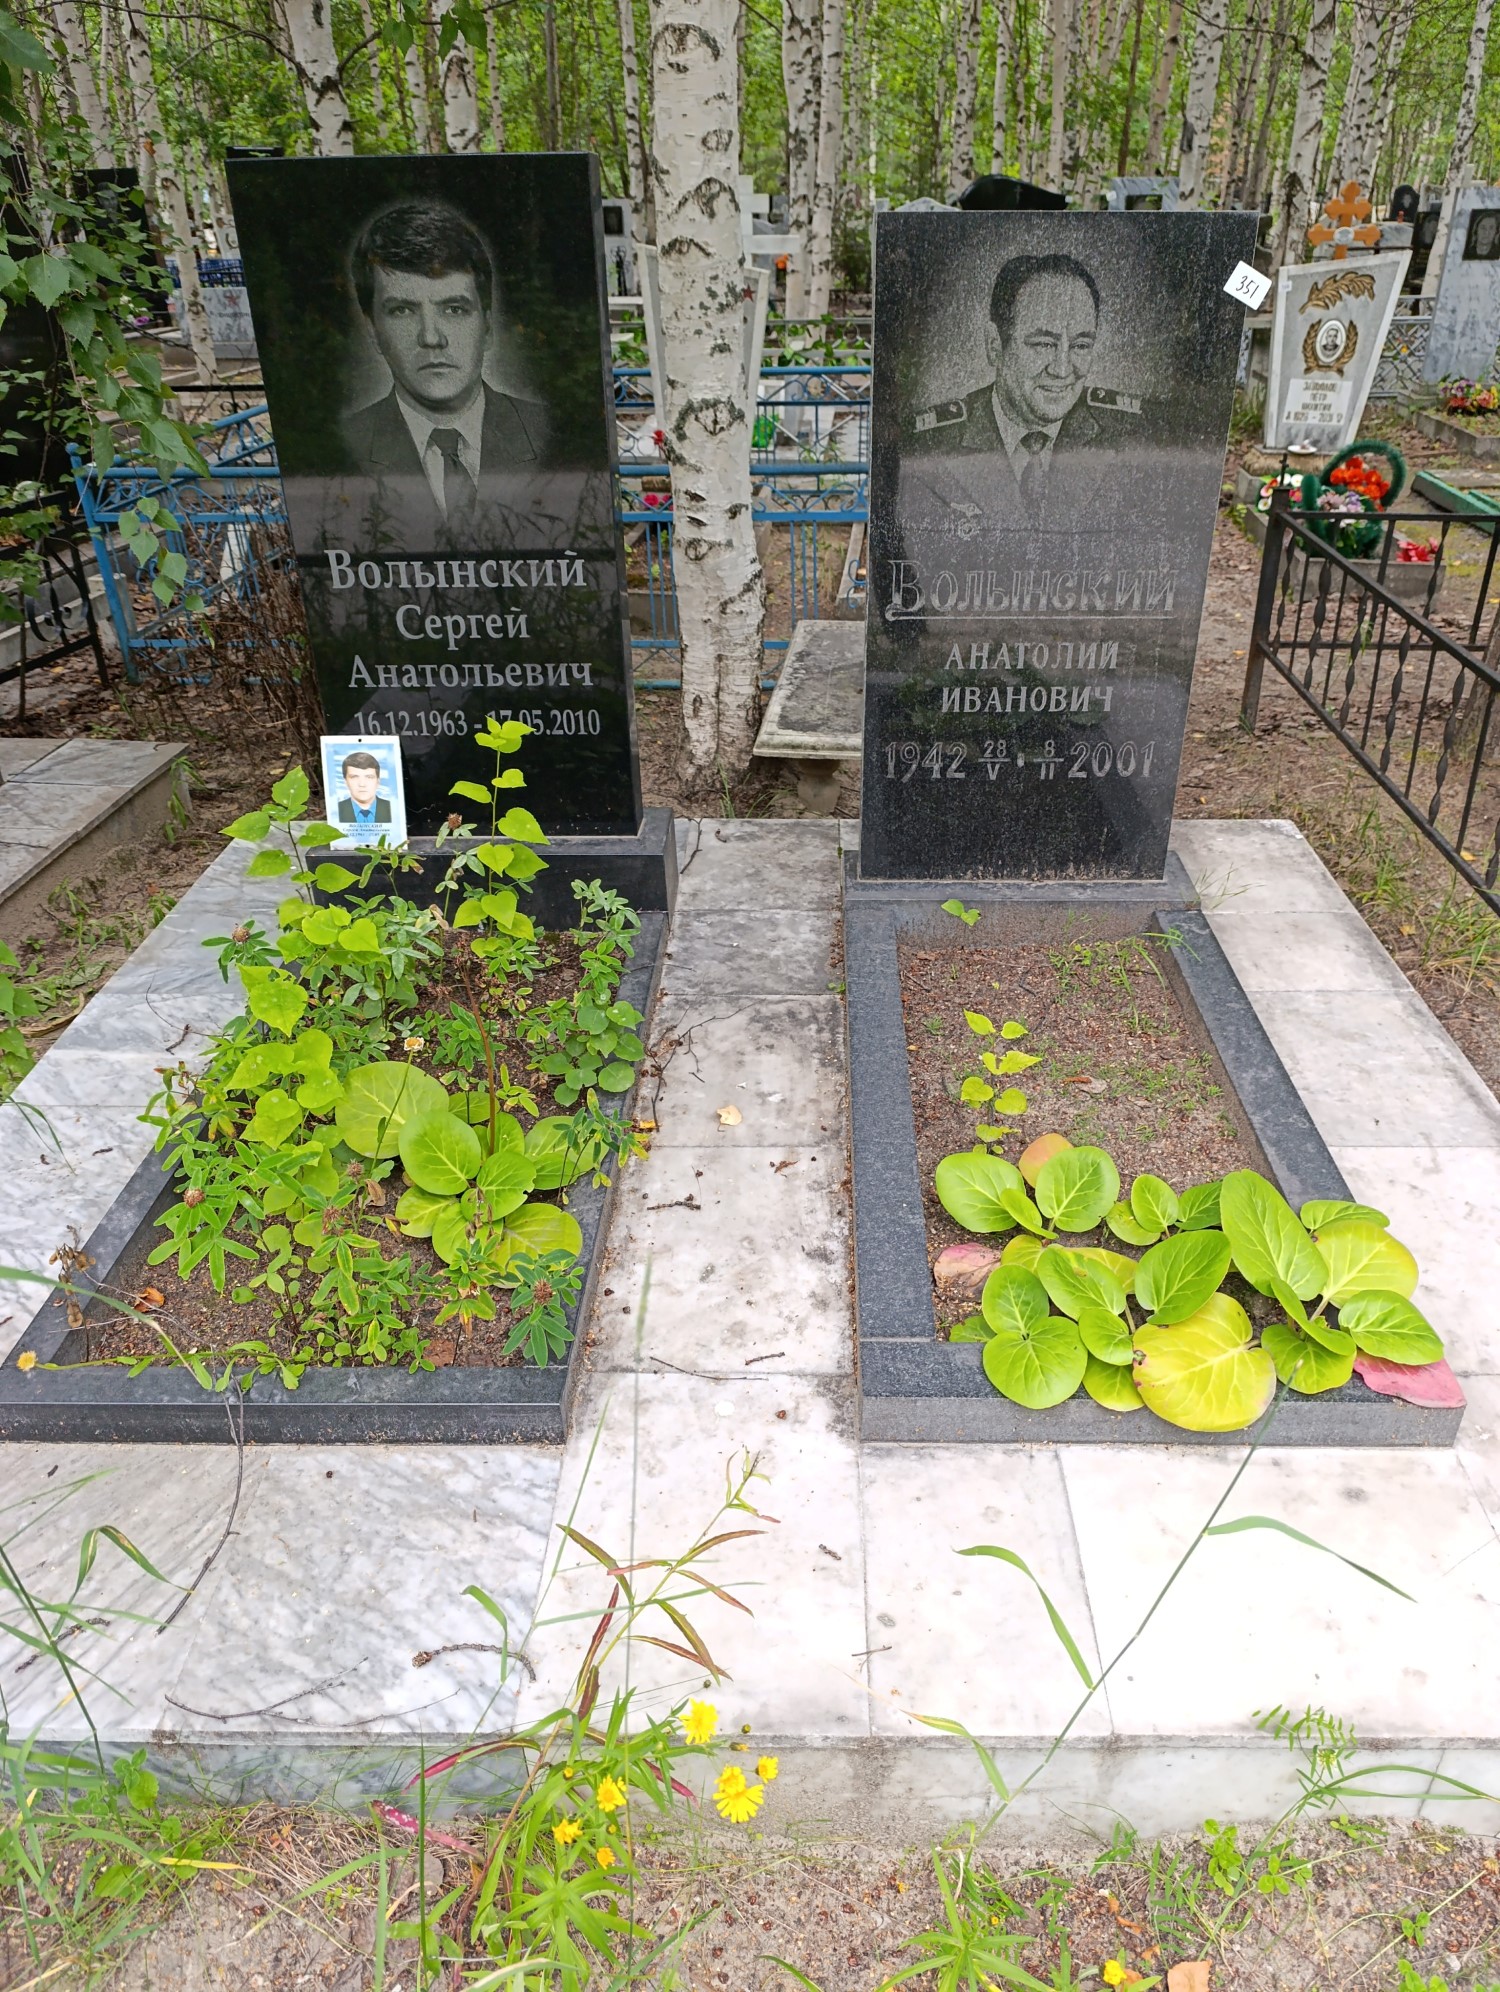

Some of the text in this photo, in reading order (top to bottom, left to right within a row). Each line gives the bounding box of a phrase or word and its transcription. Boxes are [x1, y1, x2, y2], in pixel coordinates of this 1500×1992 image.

[1235, 275, 1260, 299] 351
[324, 548, 587, 590] Волынский
[396, 604, 530, 650] Сергей
[348, 654, 594, 688] Анатольевич
[943, 640, 1120, 670] АНАТОЛИЙ
[941, 686, 1114, 713] ИВАНОВИЧ
[354, 710, 468, 736] 16.12.1963
[486, 709, 601, 736] 705.2010
[885, 741, 968, 783] 1942
[1068, 740, 1156, 779] 2001
